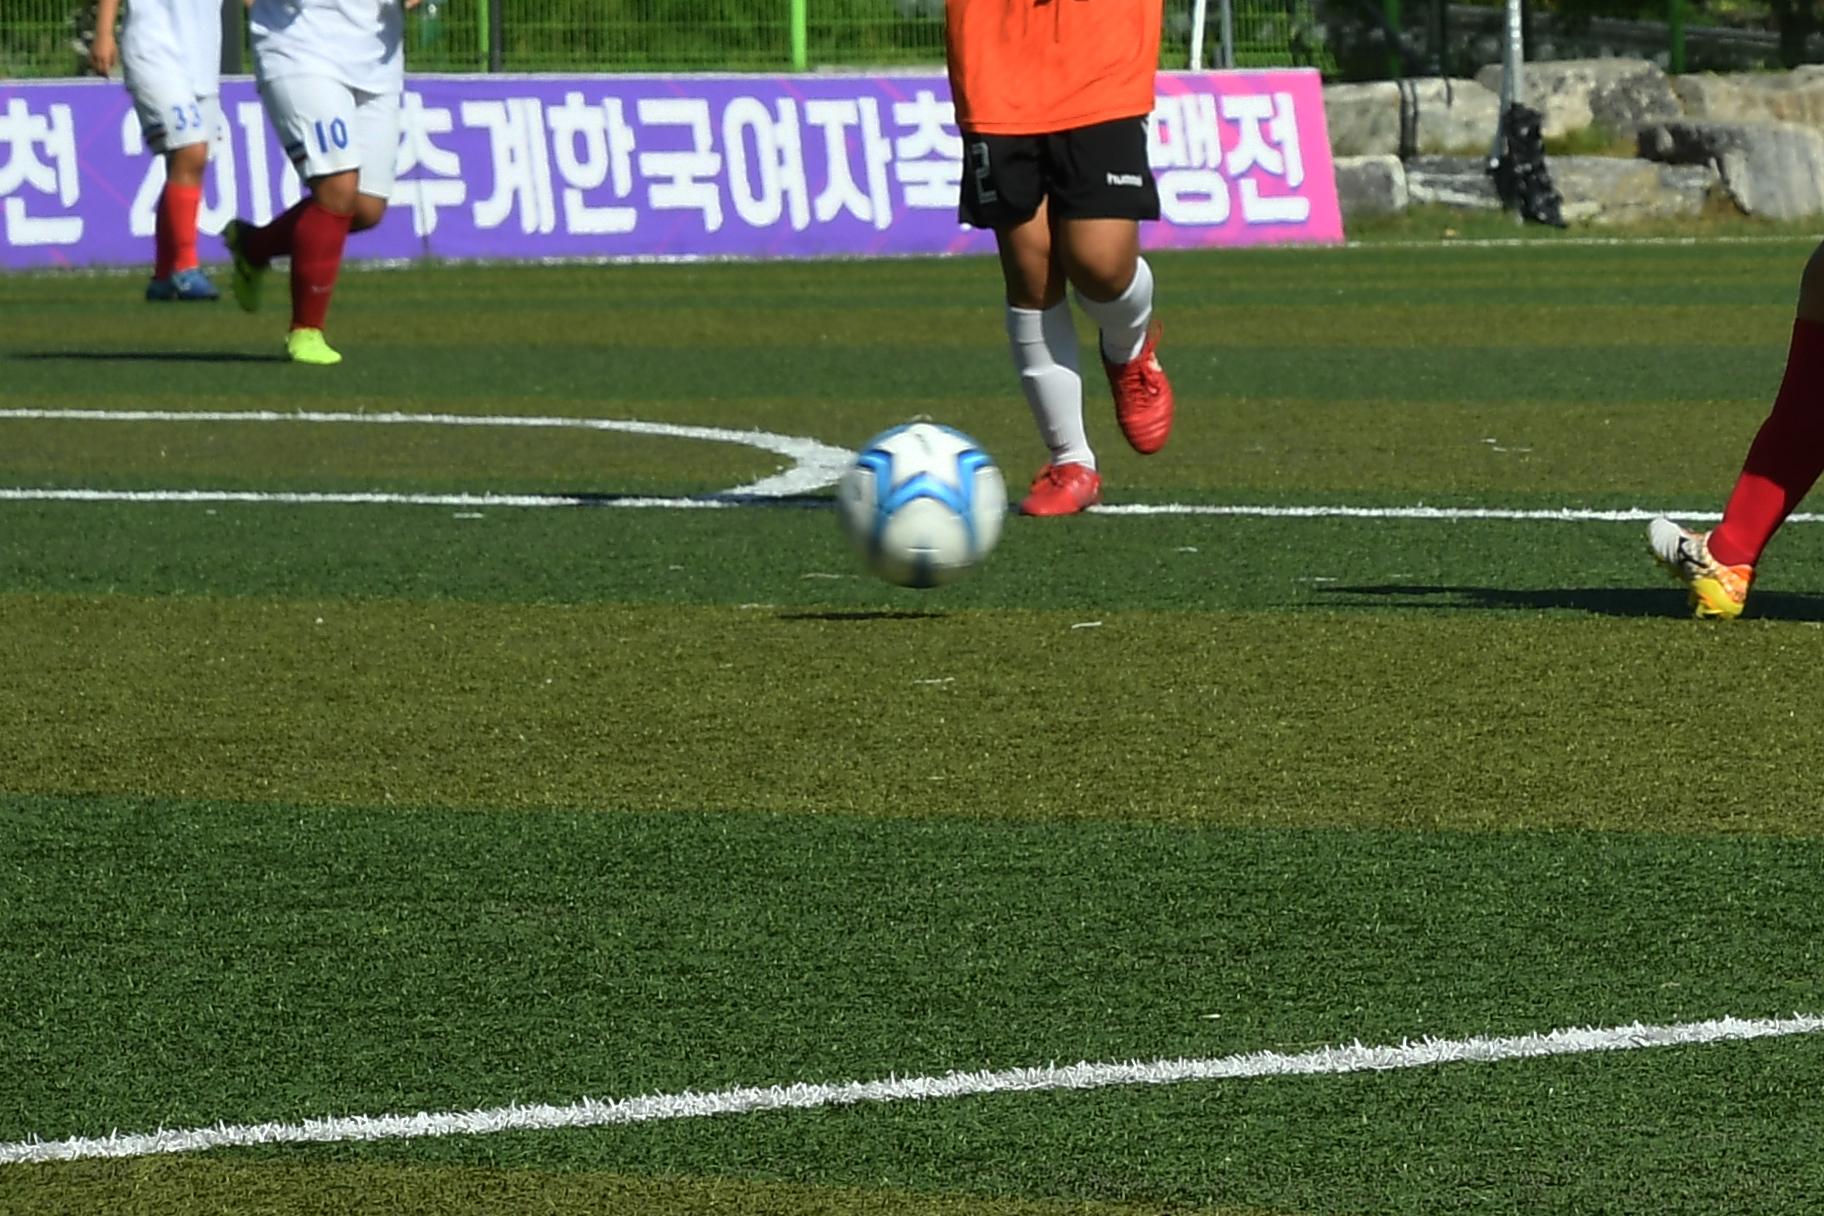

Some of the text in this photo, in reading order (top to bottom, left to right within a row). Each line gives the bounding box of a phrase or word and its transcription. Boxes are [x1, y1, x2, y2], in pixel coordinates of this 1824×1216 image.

[172, 104, 201, 130] 33
[315, 117, 348, 154] 10
[385, 90, 1311, 235] 추계한국여자축맹전
